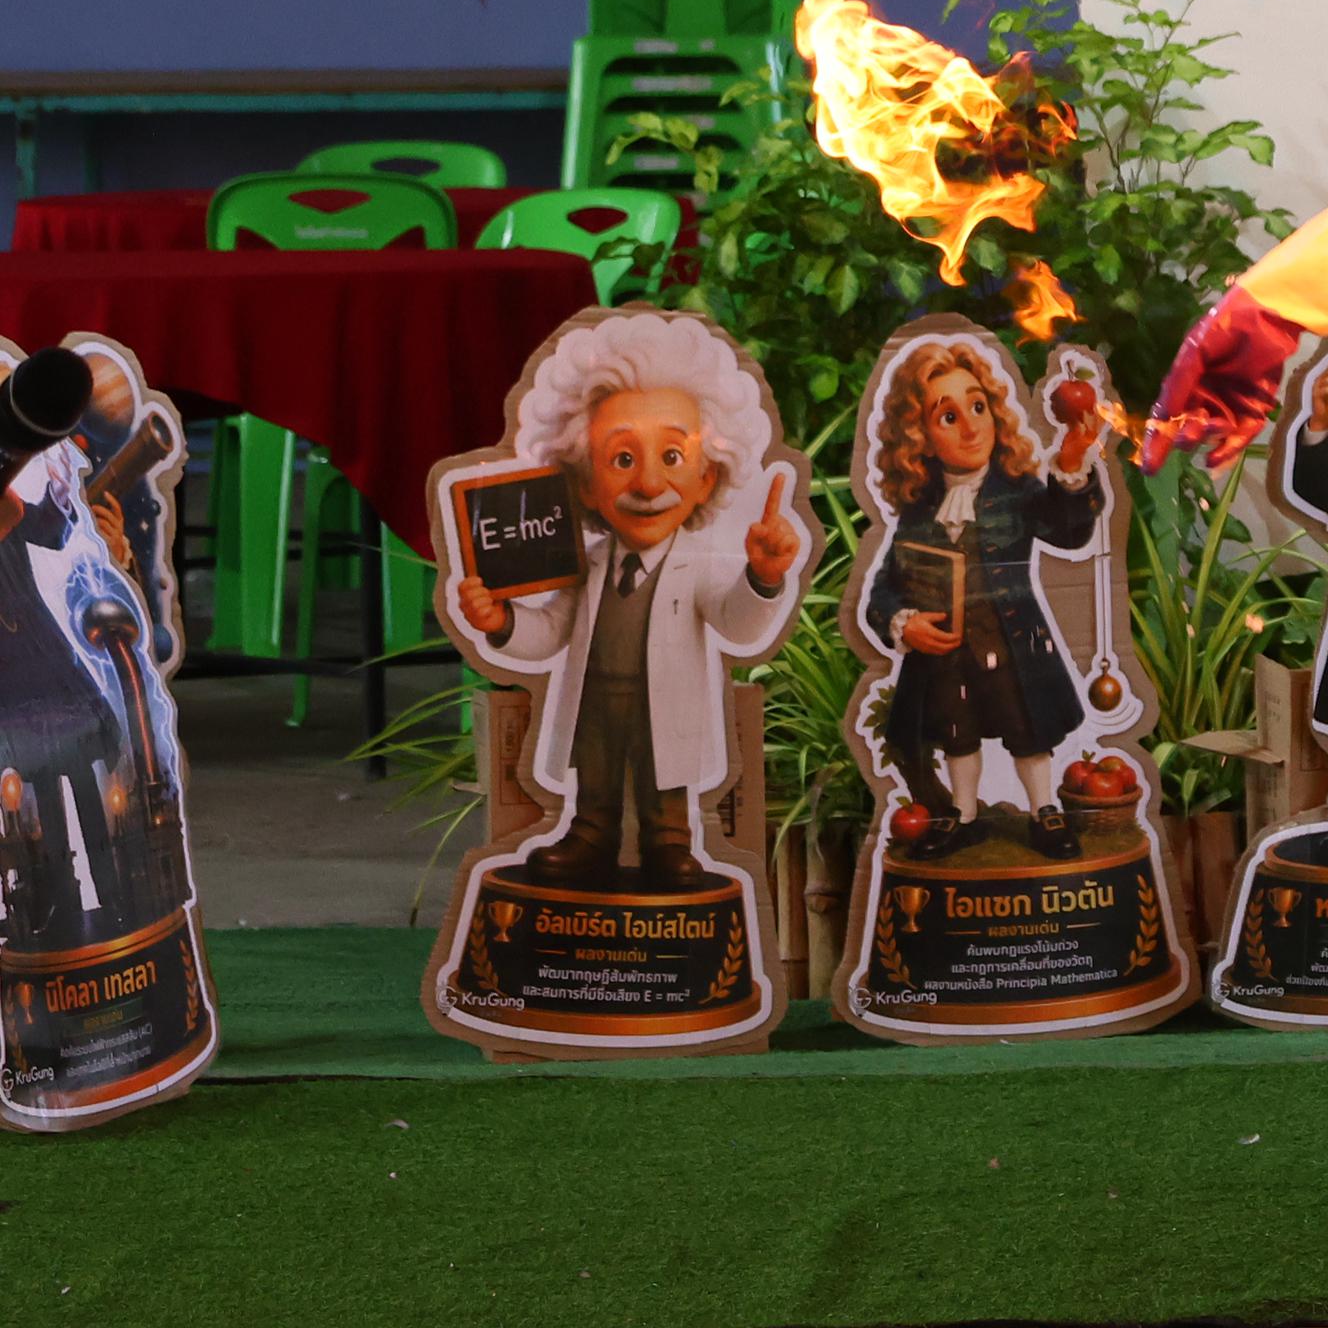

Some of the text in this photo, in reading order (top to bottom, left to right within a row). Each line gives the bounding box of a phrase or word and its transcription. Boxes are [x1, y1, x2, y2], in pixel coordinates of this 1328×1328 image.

[945, 880, 1115, 918] ไอแซก นิวตัน
[535, 911, 716, 939] อัลเบิร์ต ไอน์สไตน์
[45, 961, 157, 1013] นิโคลา เทสลา
[997, 976, 1048, 991] Principia
[1051, 968, 1118, 986] Mathematica
[461, 991, 525, 1011] KruGung
[644, 989, 652, 1002] E
[876, 989, 938, 1006] KruGung
[1233, 984, 1285, 999] KruGung
[15, 1066, 54, 1086] KruGung
